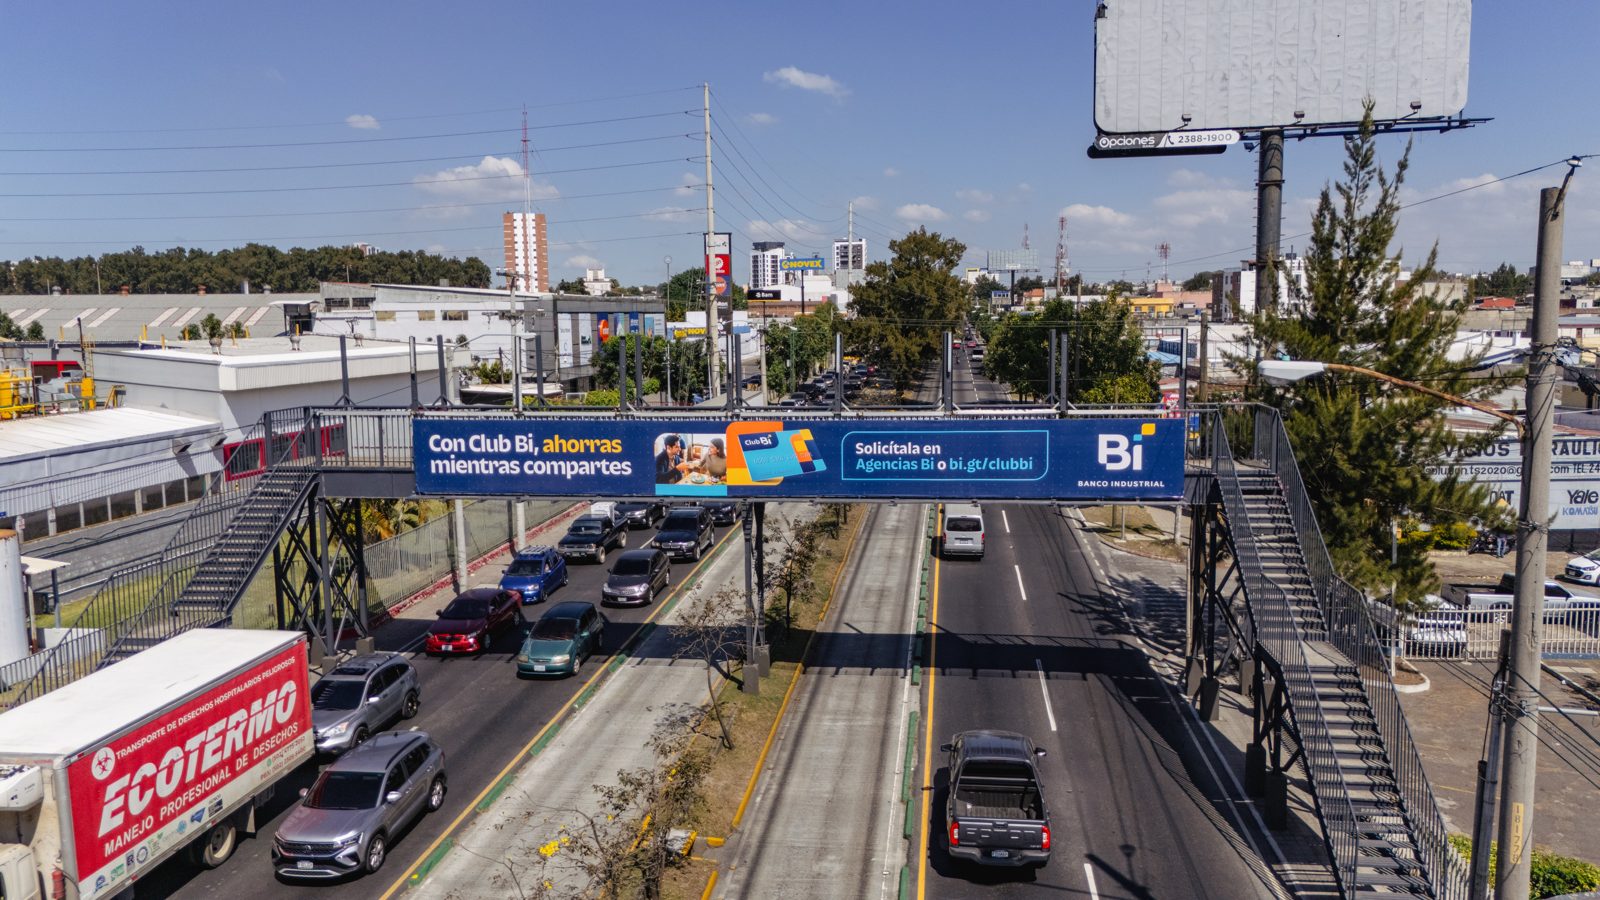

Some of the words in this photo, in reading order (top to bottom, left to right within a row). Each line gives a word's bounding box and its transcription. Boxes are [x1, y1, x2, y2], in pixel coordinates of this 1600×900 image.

[1099, 136, 1155, 148] Opciones
[1178, 133, 1232, 144] 2388-1900
[789, 259, 823, 268] NOVEX
[428, 434, 466, 453] Con
[468, 433, 512, 453] Club
[514, 433, 540, 456] Bi,
[542, 434, 623, 453] ahorras
[760, 435, 772, 445] Bi
[855, 440, 920, 455] Solicítala
[922, 444, 941, 455] en
[1551, 440, 1600, 456] RAULI
[1098, 433, 1142, 470] Bi
[430, 455, 520, 474] mientras
[523, 459, 633, 479] compartes
[856, 457, 918, 473] Agencias
[921, 457, 935, 470] Bi
[937, 460, 947, 470] o
[949, 457, 1033, 473] bi.gt/clubbi
[1110, 480, 1165, 488] INDUSTRIAL
[1567, 489, 1599, 505] Yale
[1562, 506, 1598, 516] KOMATSU
[116, 724, 165, 760] TRANSPORTE
[167, 720, 177, 732] DE
[178, 702, 214, 727] DESECHOS
[214, 675, 261, 705] HOSPITALARIOS
[261, 656, 295, 681] PELIGROSOS
[98, 680, 297, 838] ECOTERMO
[104, 815, 154, 857] MANEJO
[159, 766, 231, 821] PROFESIONAL
[235, 755, 249, 771] DE
[253, 721, 298, 760] DESECHOS
